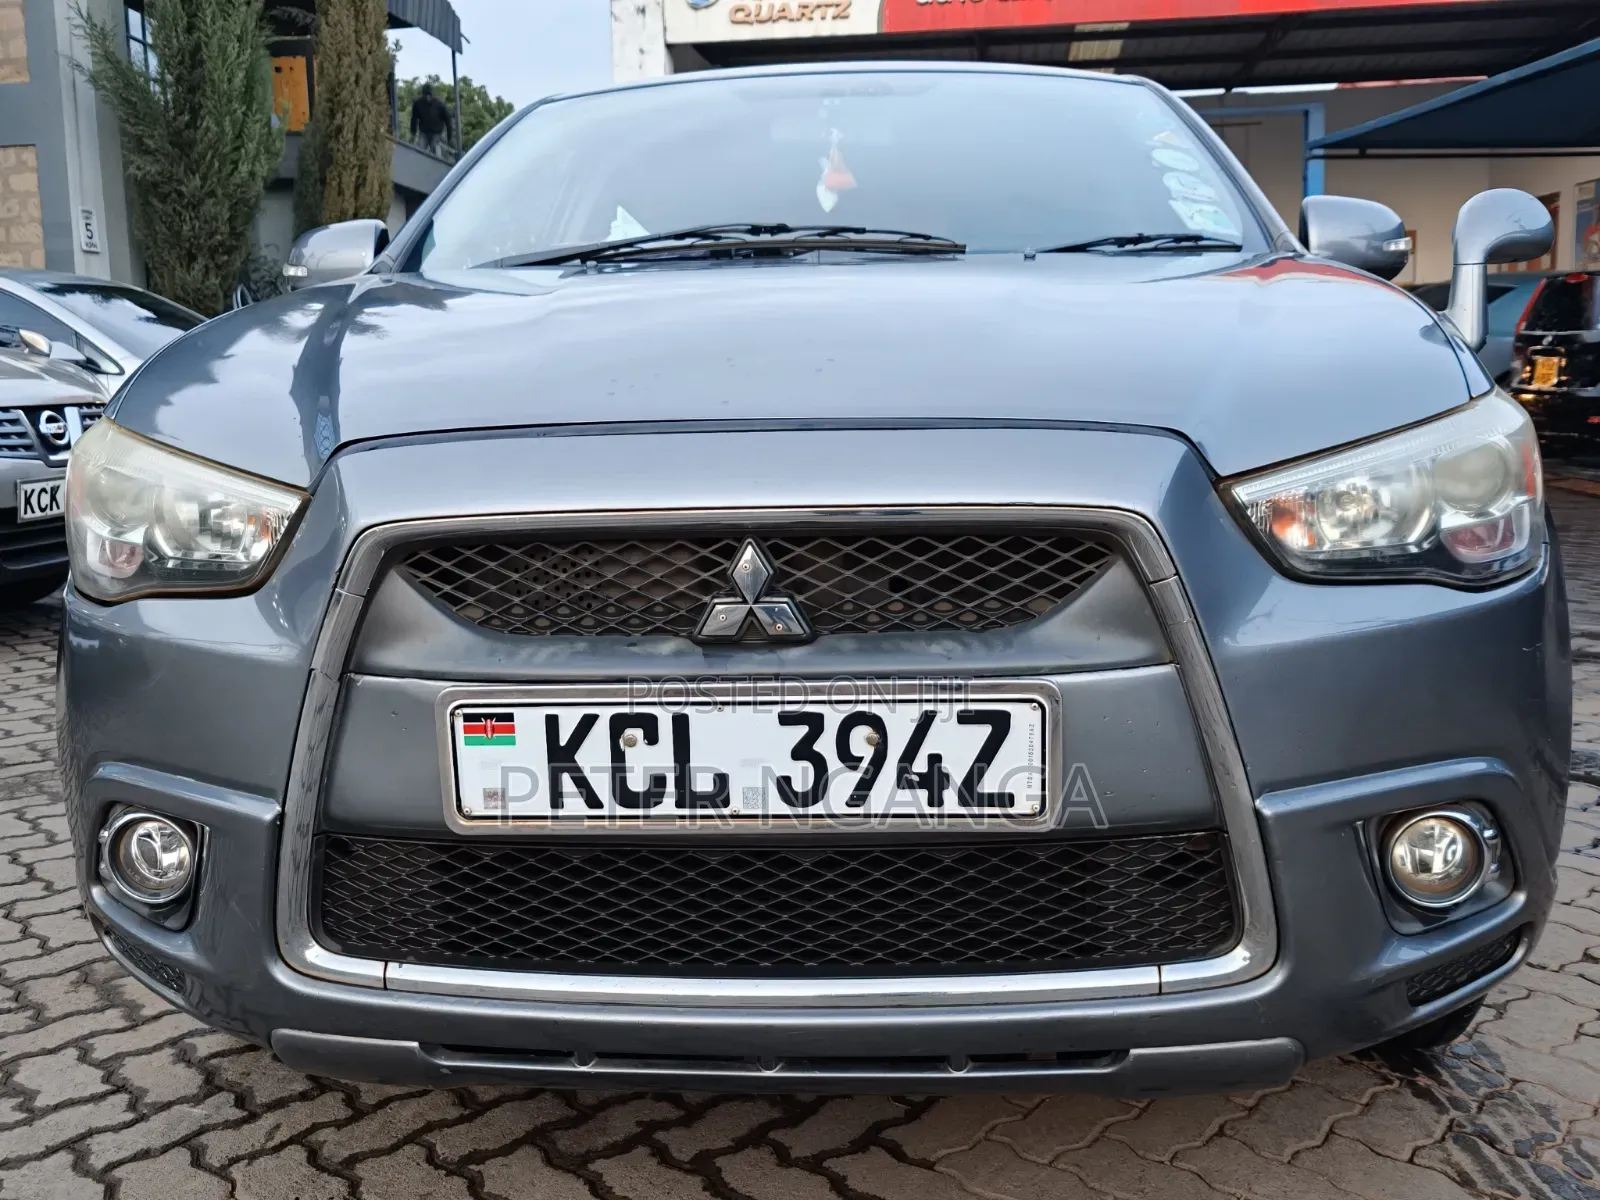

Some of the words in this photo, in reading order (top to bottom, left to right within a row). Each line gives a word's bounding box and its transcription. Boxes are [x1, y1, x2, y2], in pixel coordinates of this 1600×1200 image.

[728, 0, 851, 25] QUARTZ
[85, 222, 94, 239] 5
[23, 484, 61, 515] KCK
[545, 712, 731, 809] KCL
[776, 709, 1015, 808] 394Z
